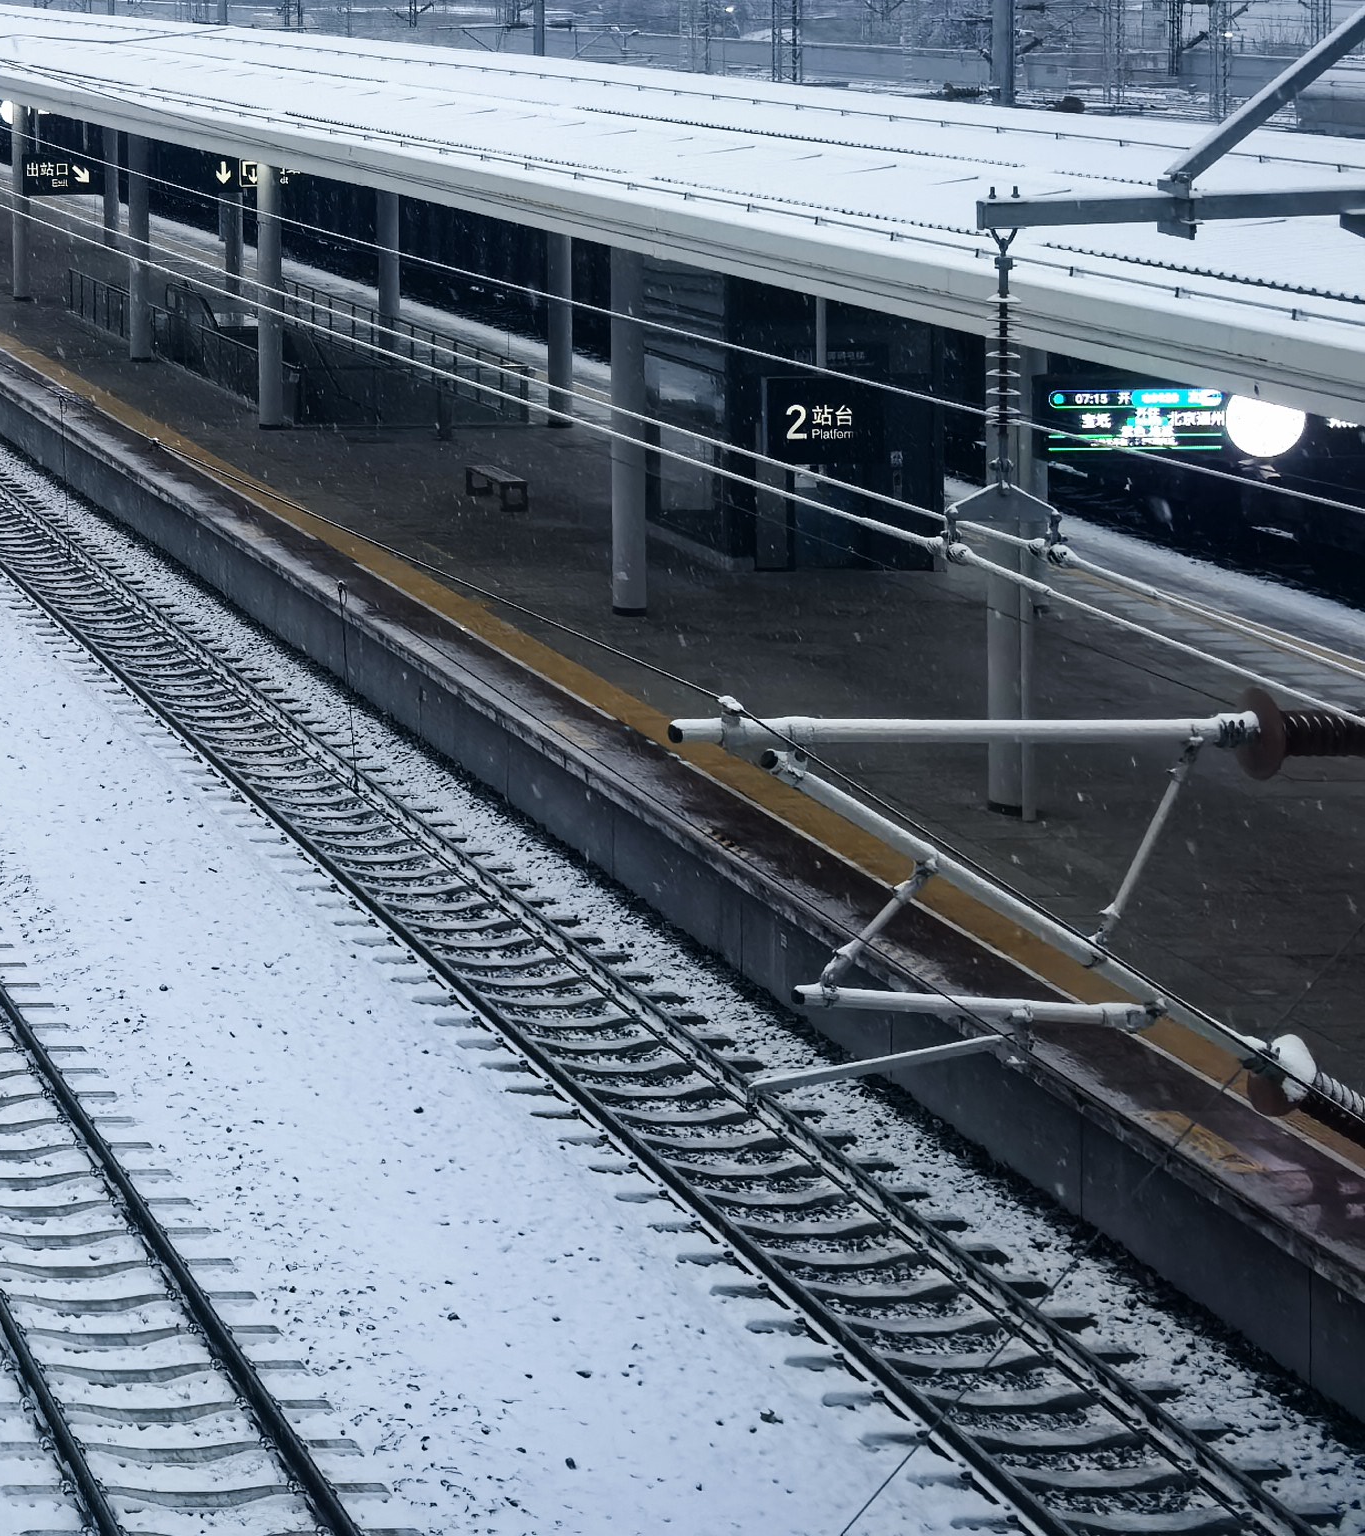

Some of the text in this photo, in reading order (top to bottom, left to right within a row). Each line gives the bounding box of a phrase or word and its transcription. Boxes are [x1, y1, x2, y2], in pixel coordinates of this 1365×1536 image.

[26, 162, 69, 177] 出站口
[51, 178, 69, 188] Exit
[1074, 392, 1109, 405] 07:15
[785, 404, 853, 440] 2 站台
